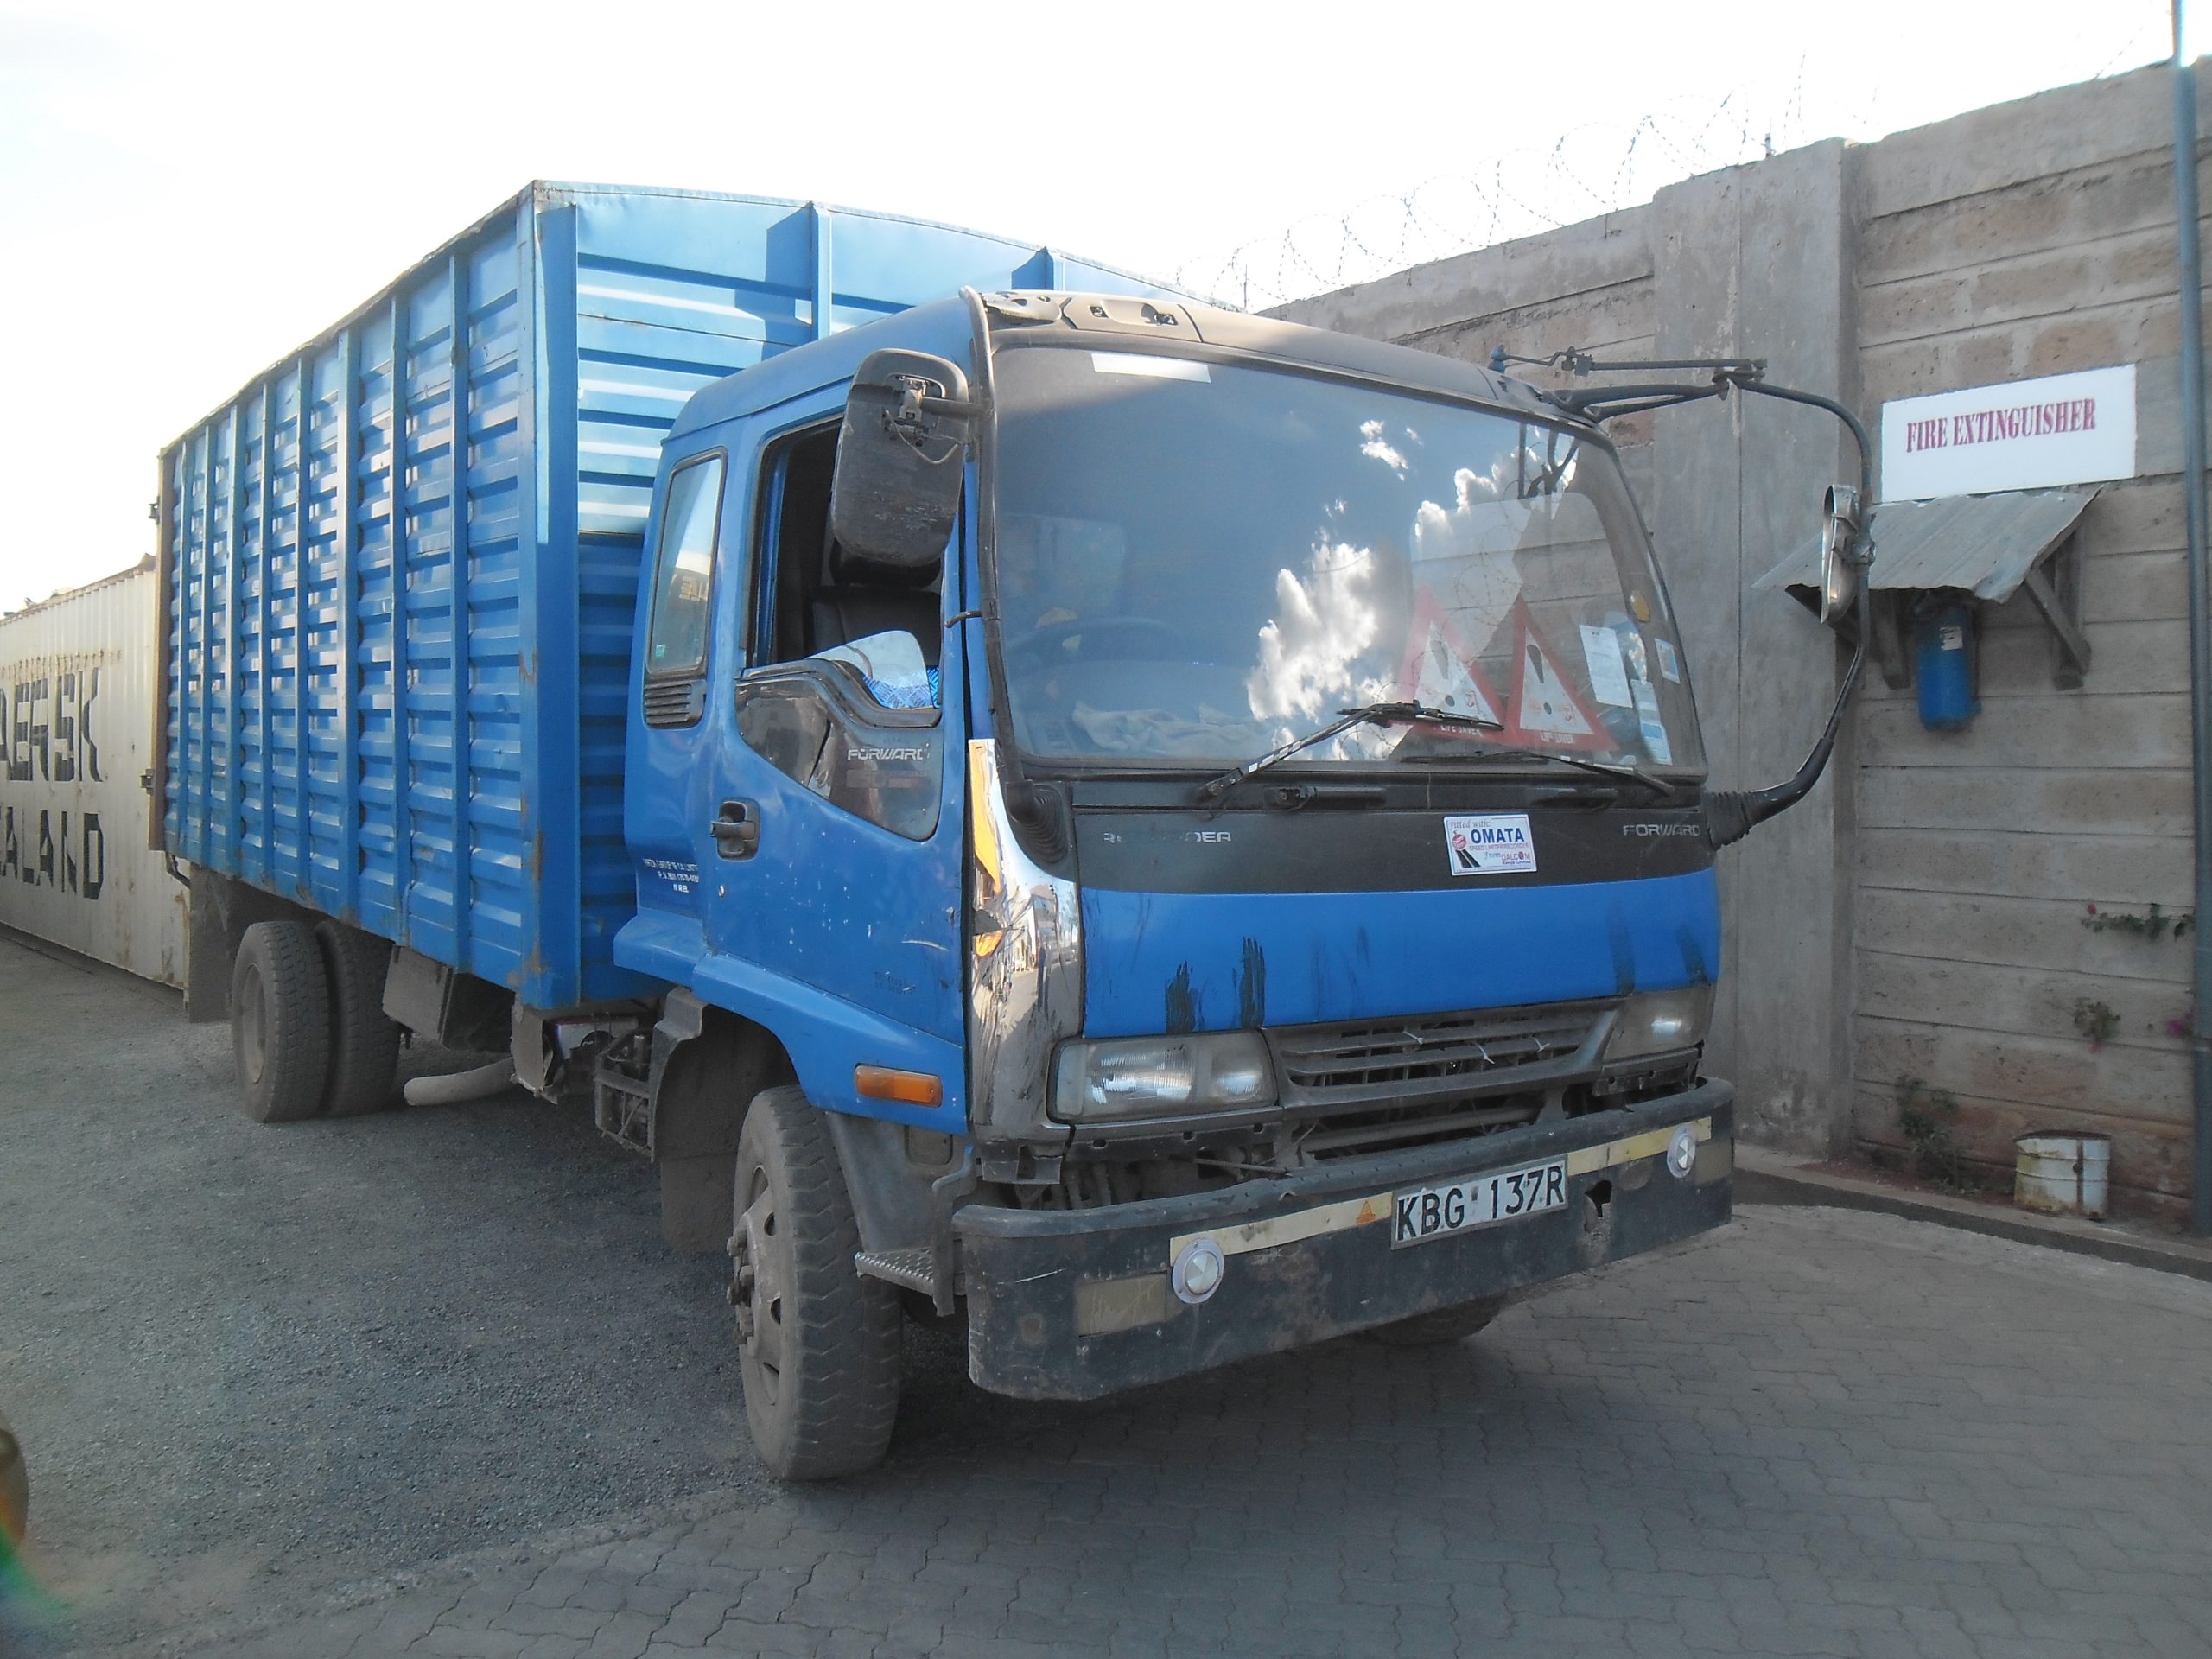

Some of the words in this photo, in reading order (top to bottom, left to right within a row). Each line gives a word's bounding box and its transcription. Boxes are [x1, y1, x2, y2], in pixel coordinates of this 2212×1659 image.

[1906, 417, 1948, 453] FIRE
[1953, 398, 2096, 446] EXTINGUISHER
[1471, 828, 1525, 844] OMATA
[1623, 823, 1700, 836] FORWARD
[1396, 1187, 1465, 1241] KBG
[1490, 1166, 1565, 1219] 137R
